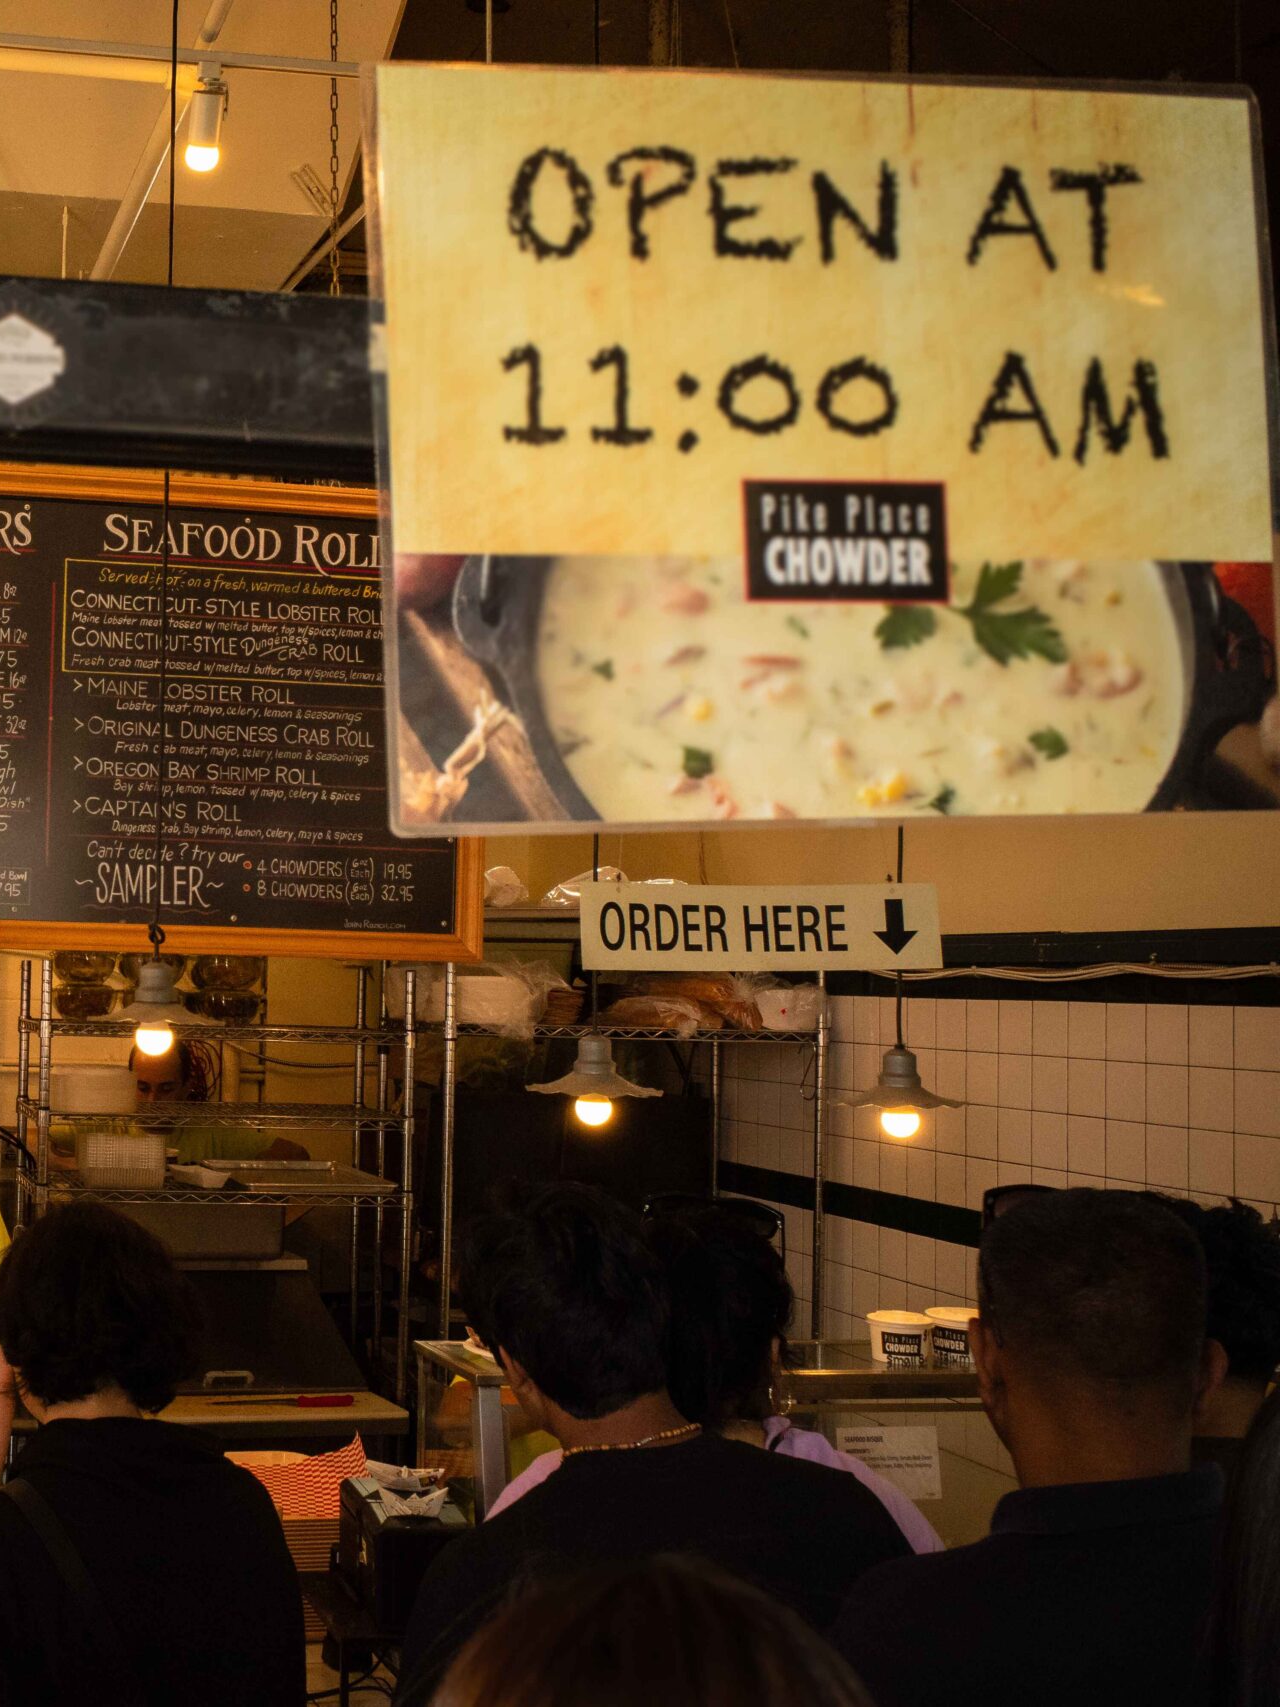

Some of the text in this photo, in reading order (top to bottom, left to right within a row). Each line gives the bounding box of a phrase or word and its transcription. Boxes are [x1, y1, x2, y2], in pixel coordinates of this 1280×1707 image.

[507, 145, 1143, 272] OPEN AT
[500, 344, 1170, 465] 11:00 AM
[762, 494, 932, 535] Pike Place
[104, 513, 281, 560] SEAFOOD
[765, 536, 932, 588] CHOWDER
[268, 602, 340, 622] LOBSTER
[240, 635, 309, 657] Dungeness
[278, 644, 364, 663] CRAB ROLL
[88, 677, 294, 705] MAINE LOBSTER ROLL
[88, 716, 375, 748] ORIGINAL DUNGENESS CRAB ROLL
[86, 757, 322, 786] OREGON BAY SHRIMP ROLL
[85, 796, 242, 822] CAPTAIN'S ROLL
[87, 840, 245, 868] Can't try our
[257, 858, 413, 880] 4 CHOWDERS 19.95
[96, 862, 210, 908] SAMPLER
[257, 879, 415, 901] 8 CHOWDERS 32.95
[599, 901, 849, 953] ORDER HERE
[885, 1342, 918, 1353] CHOWDER
